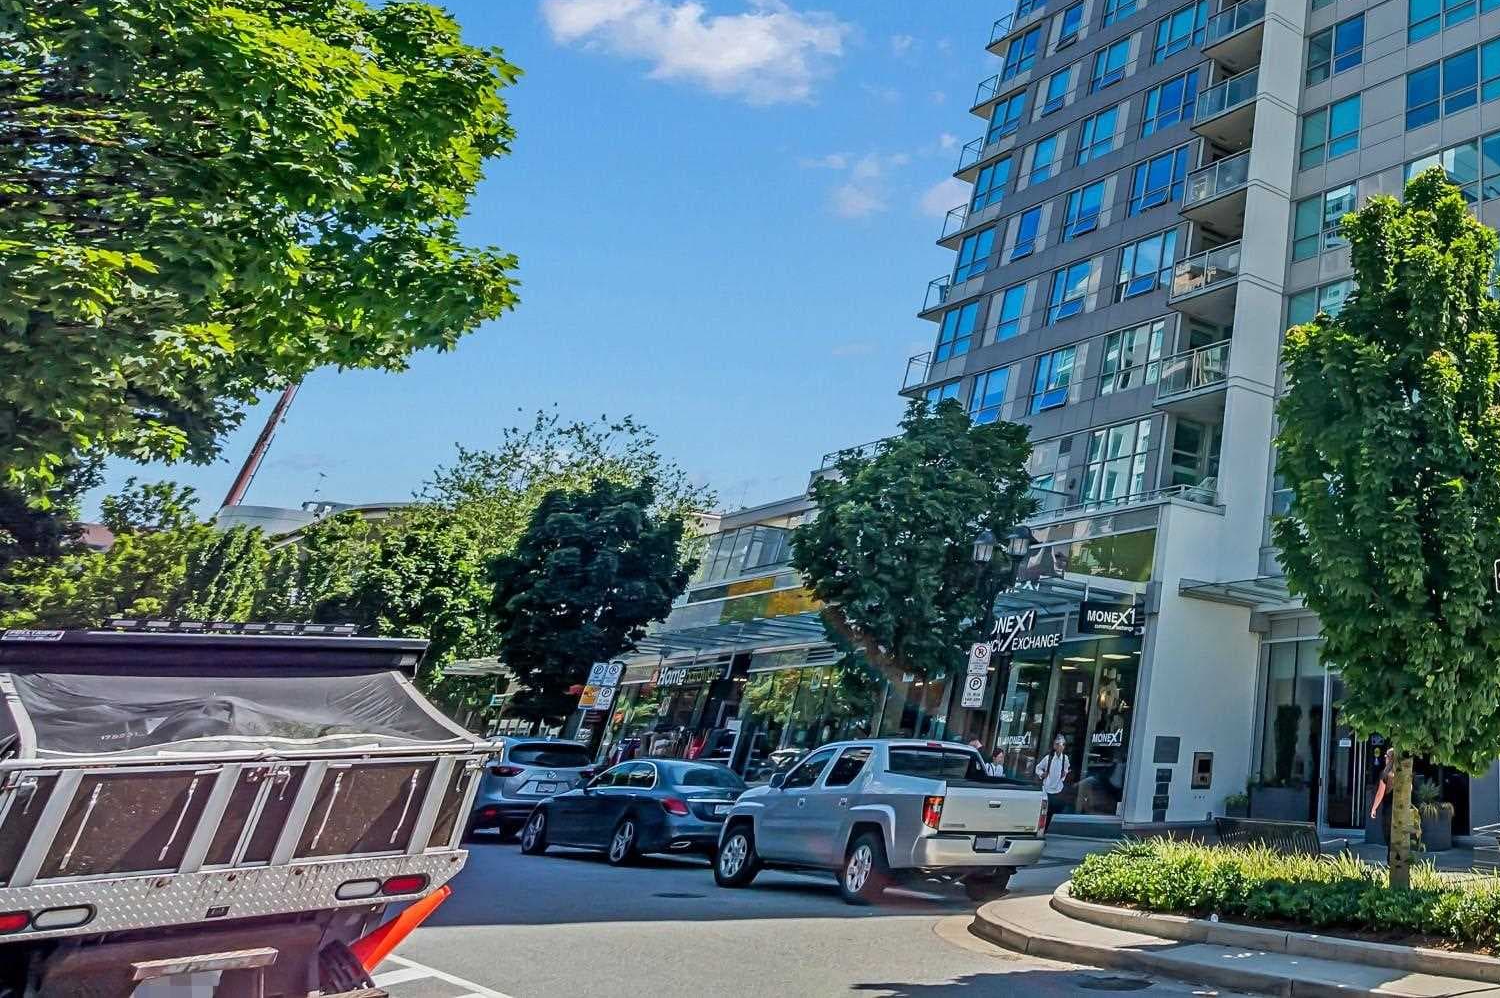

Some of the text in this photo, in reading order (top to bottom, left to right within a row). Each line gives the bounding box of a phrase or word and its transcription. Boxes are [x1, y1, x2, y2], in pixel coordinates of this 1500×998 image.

[1087, 608, 1136, 629] MONEX1
[1011, 634, 1061, 651] EXCHANGE
[658, 666, 686, 685] Home
